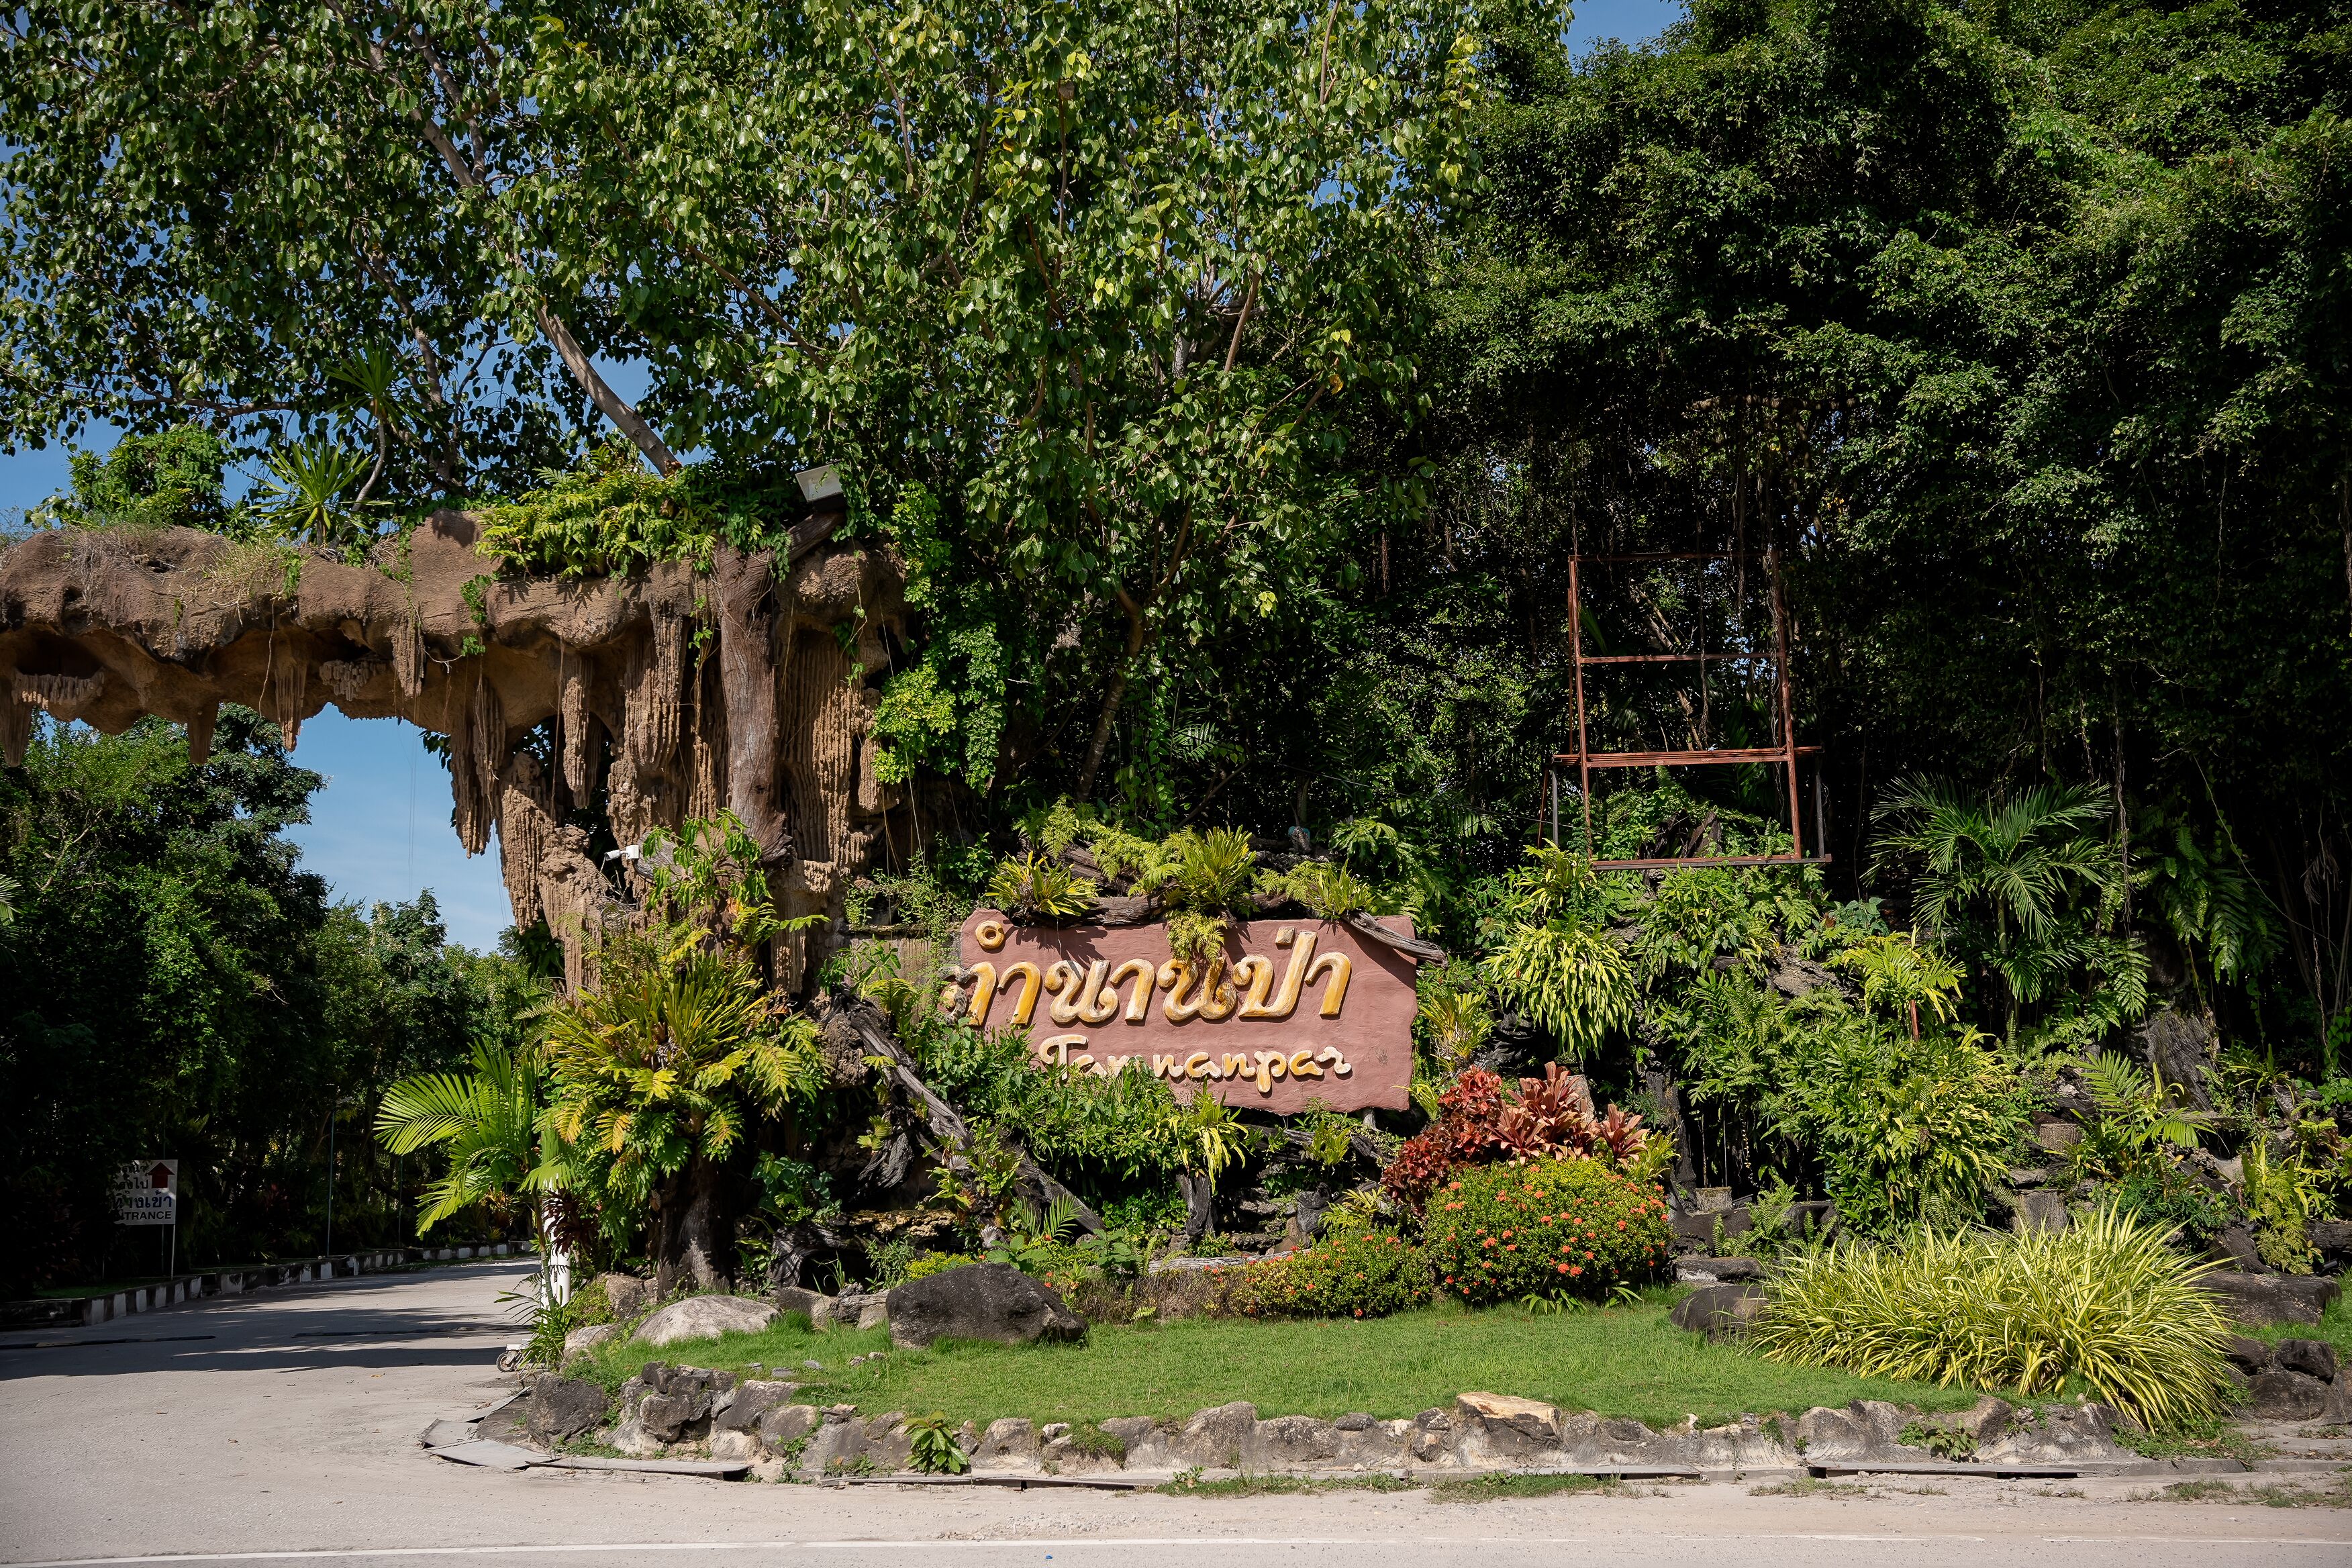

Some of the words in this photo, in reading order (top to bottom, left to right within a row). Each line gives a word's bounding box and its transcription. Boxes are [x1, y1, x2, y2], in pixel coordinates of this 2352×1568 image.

[938, 920, 1351, 1026] ตำนานป่า
[113, 1210, 173, 1220] NTRANCE
